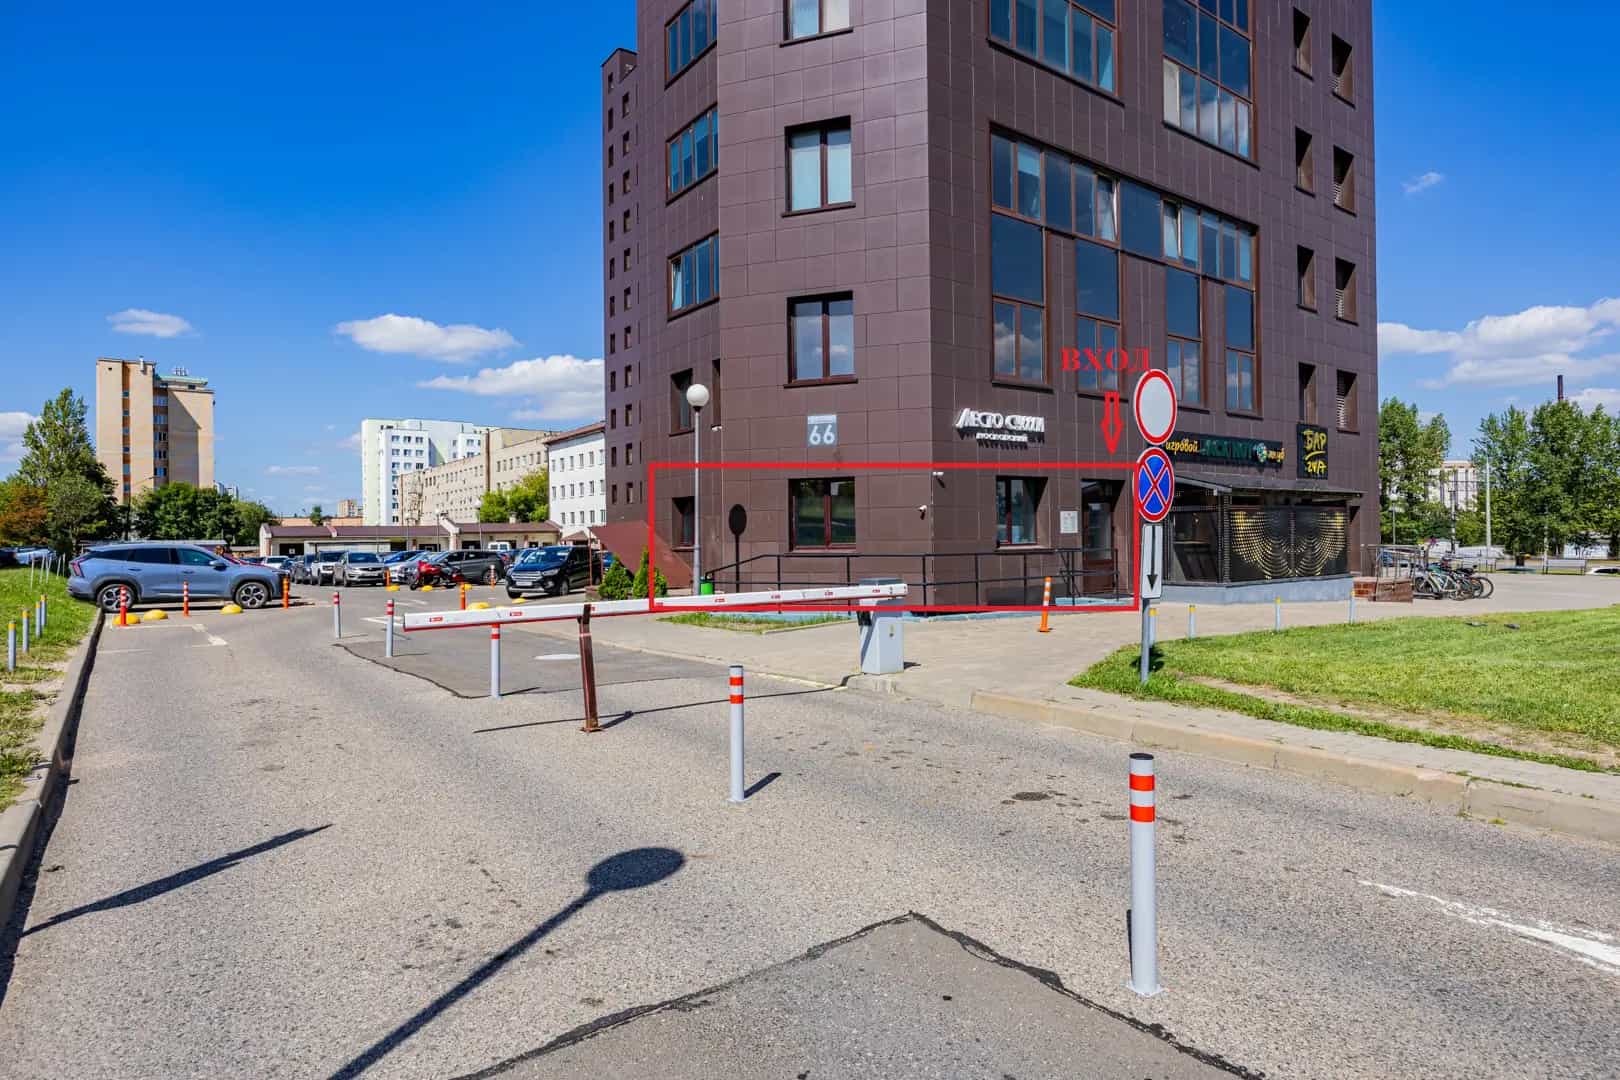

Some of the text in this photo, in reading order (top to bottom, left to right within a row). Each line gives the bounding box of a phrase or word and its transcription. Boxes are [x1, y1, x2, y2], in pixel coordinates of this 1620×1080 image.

[809, 424, 835, 445] 66
[1302, 429, 1327, 451] БАР
[1166, 438, 1198, 455] игровой
